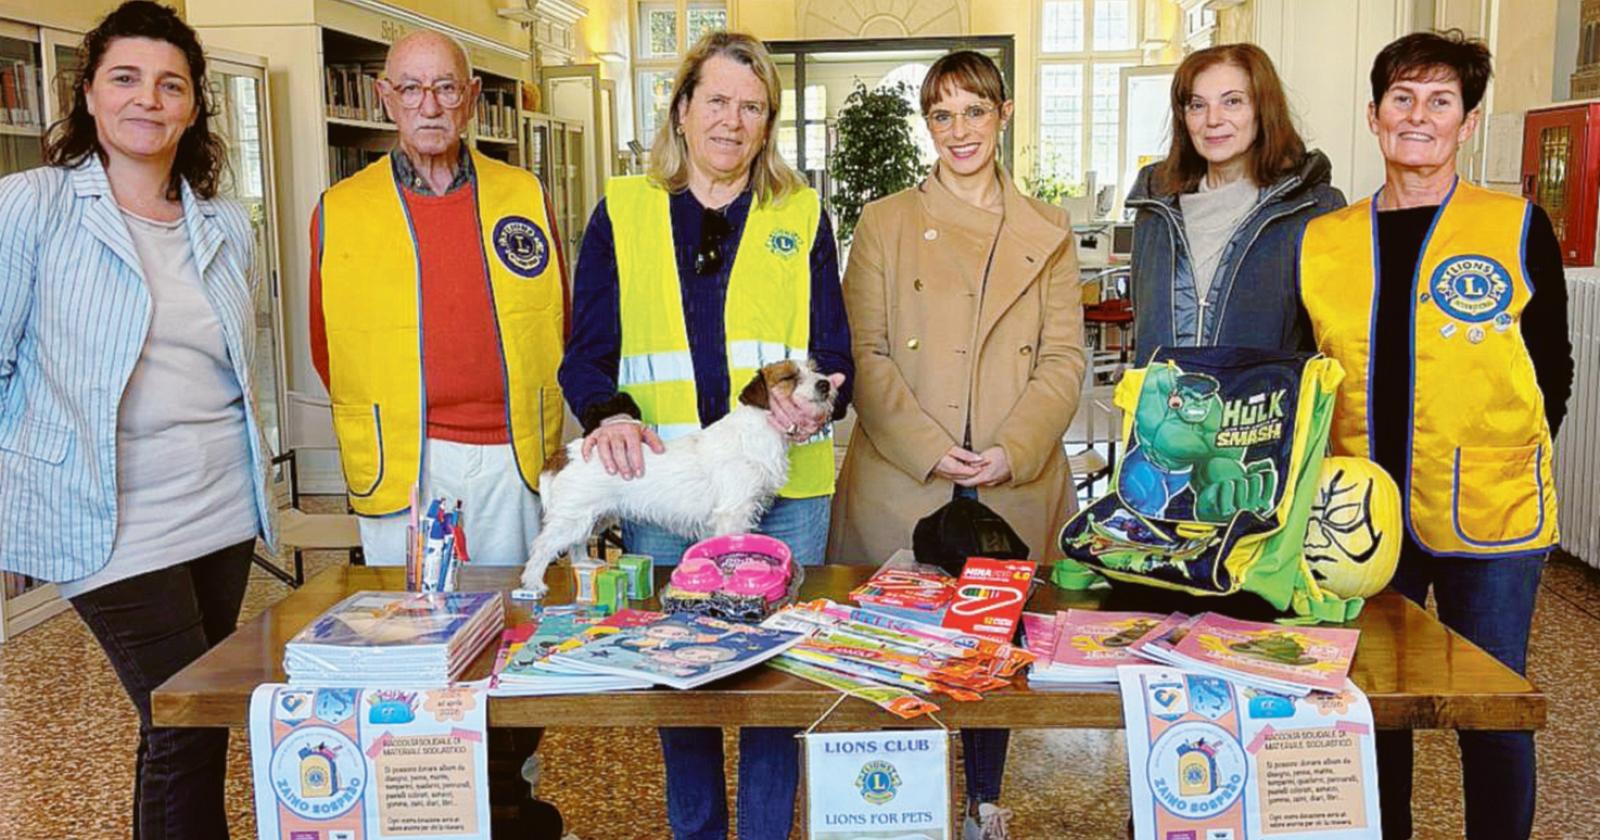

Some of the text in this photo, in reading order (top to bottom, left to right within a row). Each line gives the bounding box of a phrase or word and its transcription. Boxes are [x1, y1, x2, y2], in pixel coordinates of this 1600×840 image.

[515, 235, 529, 254] L
[780, 238, 791, 249] L
[1450, 260, 1492, 274] LIONS
[1463, 276, 1483, 296] L
[1222, 388, 1287, 427] HULK
[1216, 421, 1282, 446] SMASH
[824, 739, 930, 753] LIONS CLUB
[873, 772, 886, 790] L
[277, 778, 309, 811] ZAINO
[1154, 777, 1188, 810] ZAINO
[825, 811, 933, 826] LIONS FOR PETS
